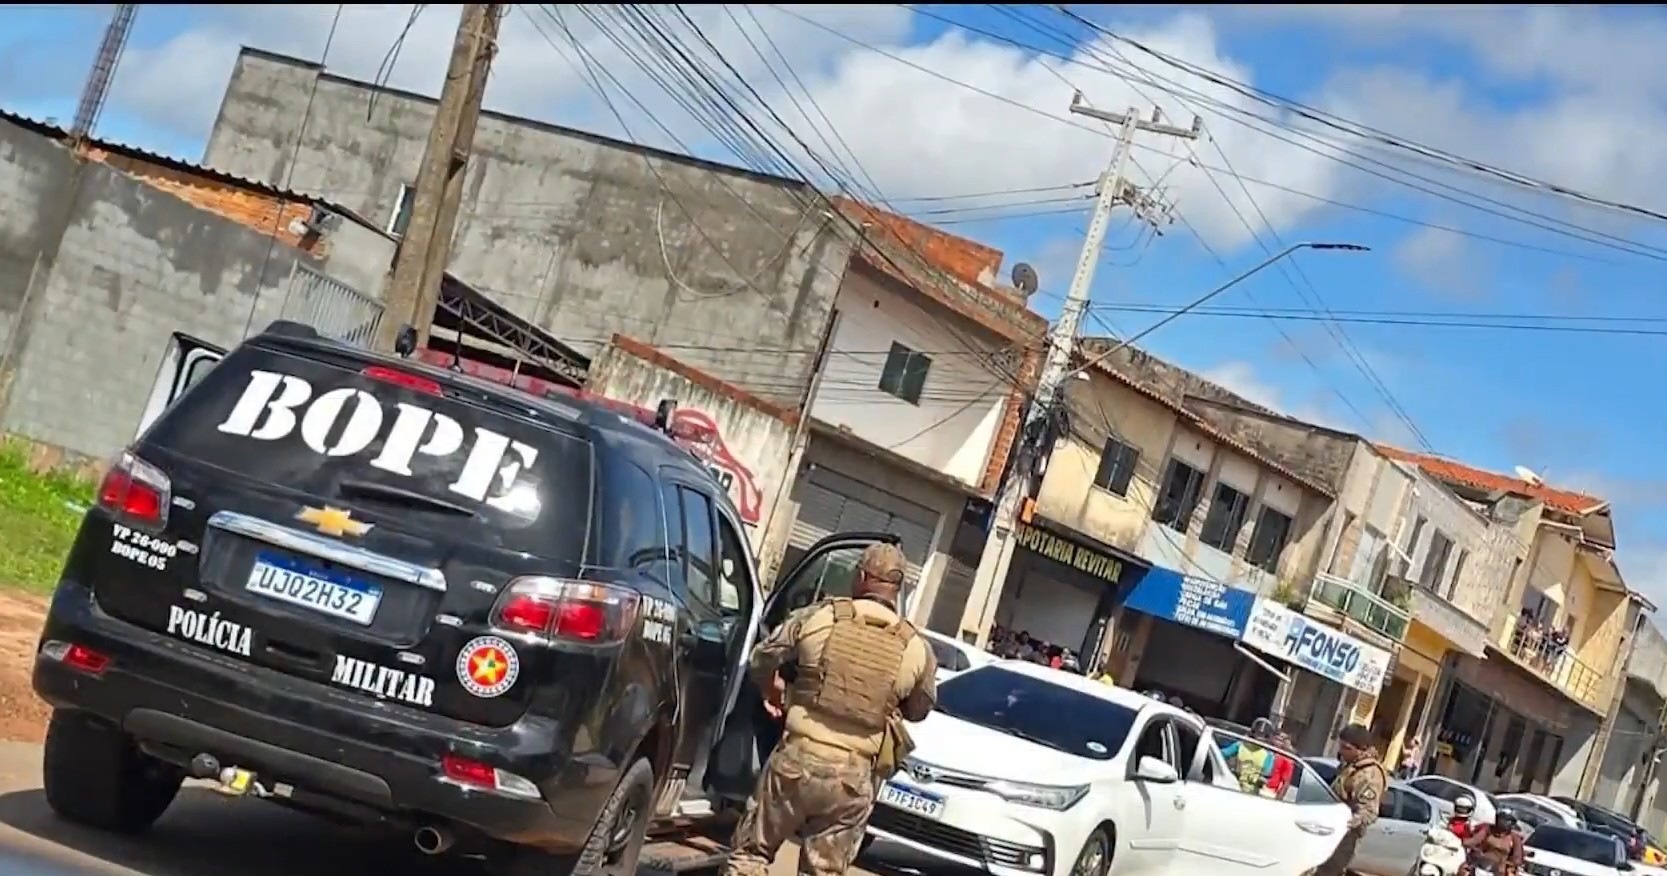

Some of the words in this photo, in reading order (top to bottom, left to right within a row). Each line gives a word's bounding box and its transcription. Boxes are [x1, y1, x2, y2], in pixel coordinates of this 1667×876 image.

[217, 370, 539, 520] BOPE
[111, 540, 149, 565] BOPE
[1016, 524, 1075, 566] APOTARIA
[167, 605, 251, 656] POLÍCIA
[331, 654, 436, 707] MILITAR
